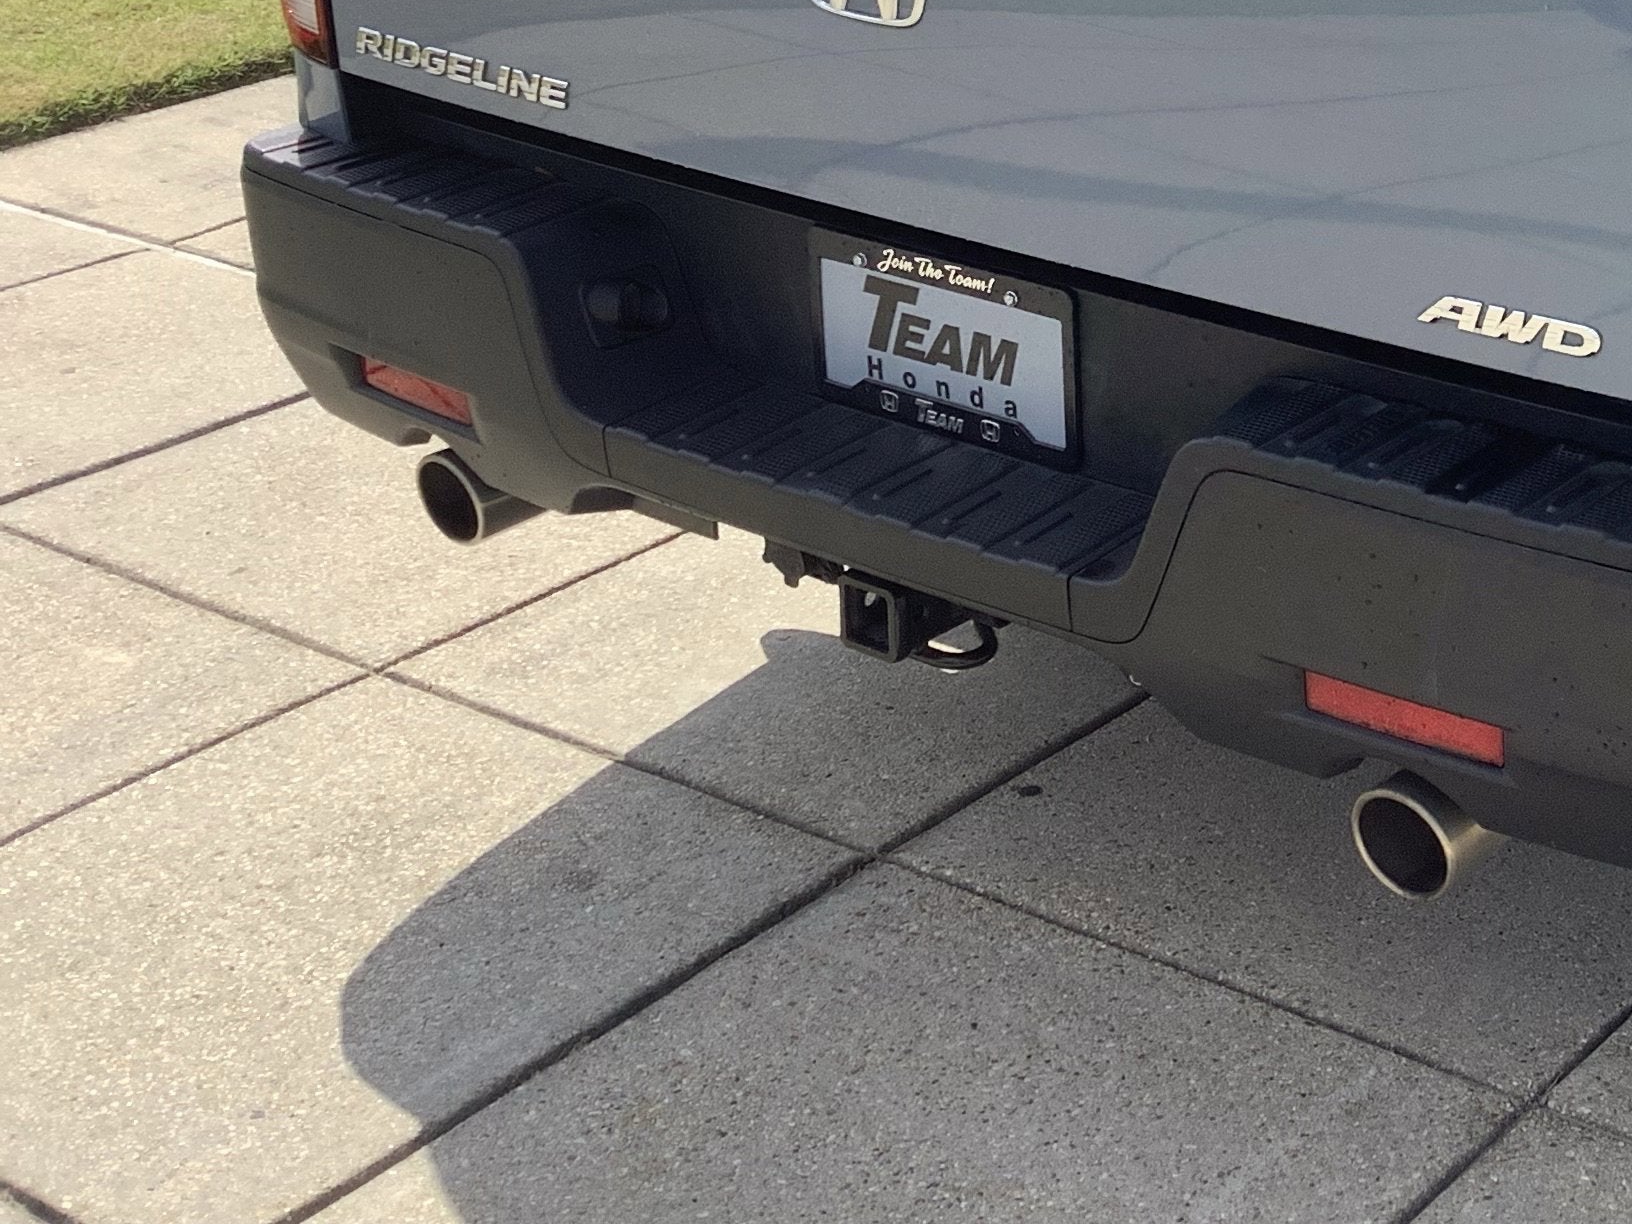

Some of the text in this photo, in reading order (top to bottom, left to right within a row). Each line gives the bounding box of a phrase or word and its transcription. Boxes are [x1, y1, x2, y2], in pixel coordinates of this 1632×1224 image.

[356, 26, 569, 109] RIDGELINE
[877, 248, 995, 293] Join The Team!
[863, 274, 1019, 387] TEAM
[1417, 295, 1602, 358] AWD
[867, 355, 1018, 419] Honda
[914, 397, 964, 435] TEAM
